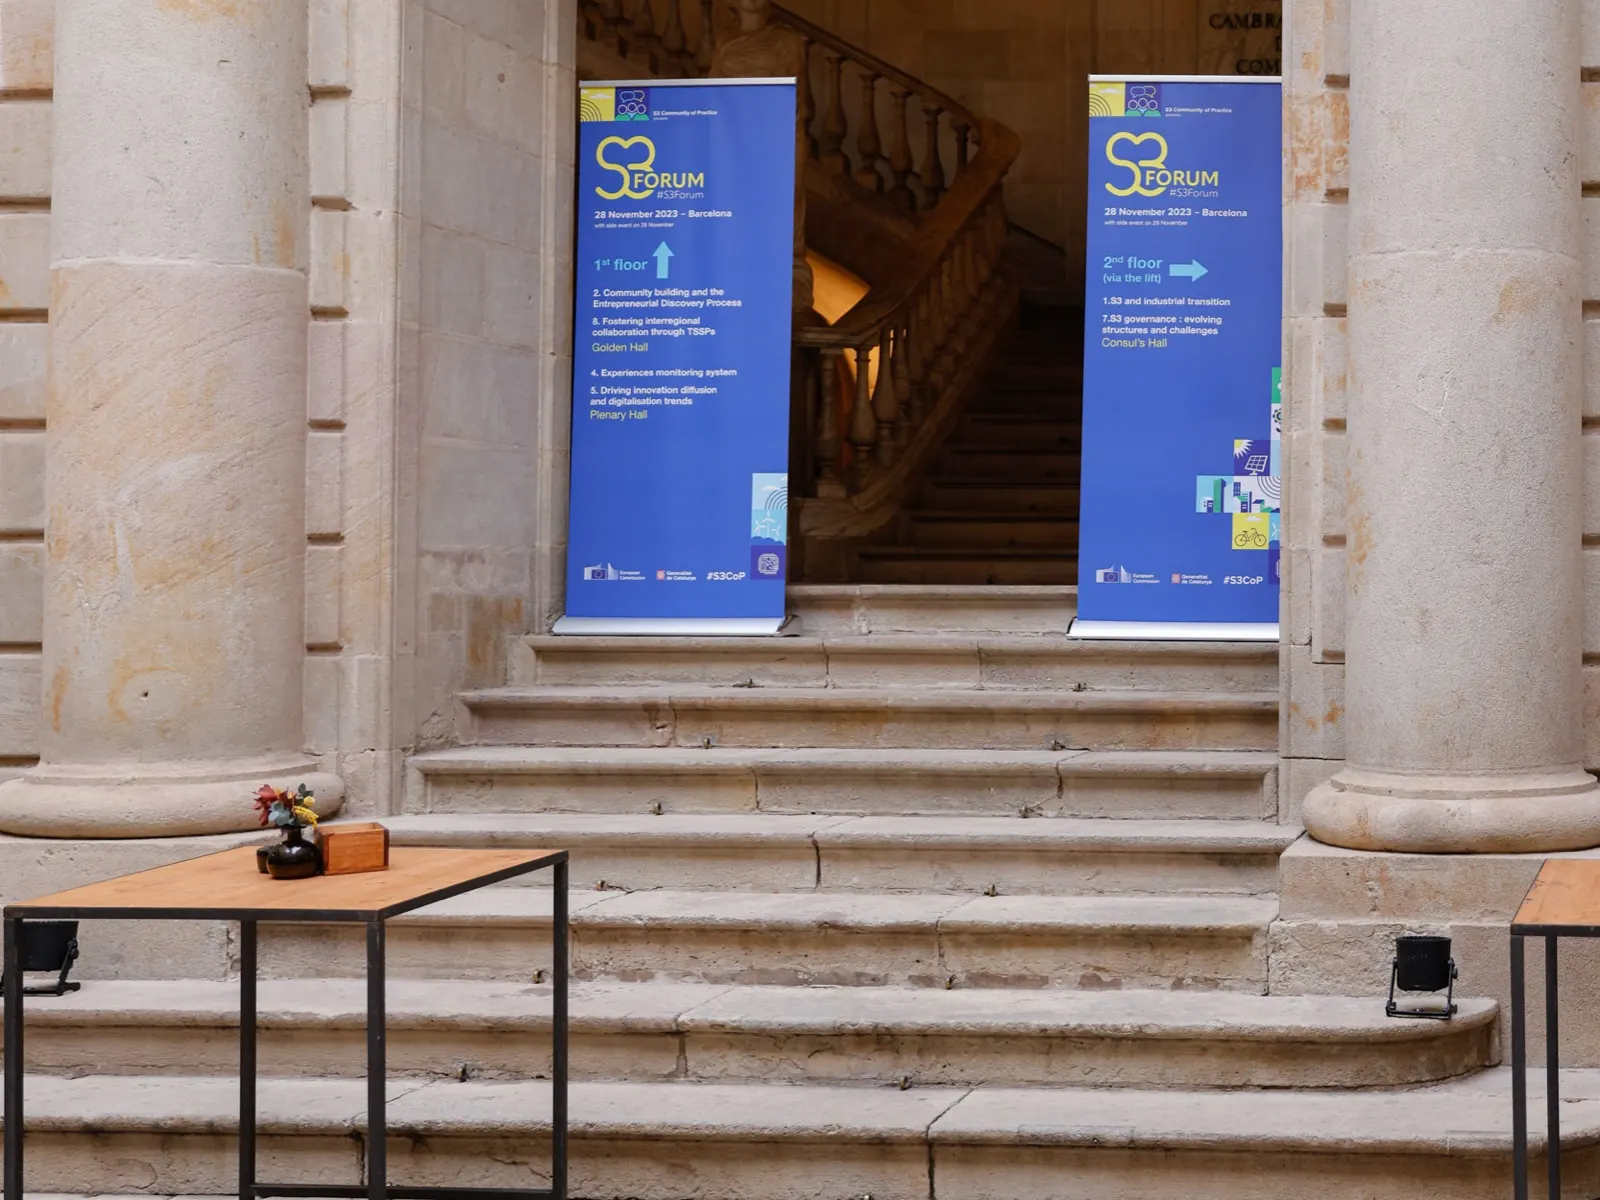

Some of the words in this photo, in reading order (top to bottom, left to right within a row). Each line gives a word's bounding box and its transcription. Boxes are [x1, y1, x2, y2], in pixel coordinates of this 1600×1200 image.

[1236, 59, 1281, 74] COM
[633, 172, 704, 189] FORUM
[1145, 170, 1219, 187] FORUM
[656, 190, 704, 200] #S3Forum
[1169, 188, 1218, 198] #S3Forum
[594, 210, 606, 219] 28
[608, 210, 653, 219] November
[655, 210, 678, 218] 2023
[688, 209, 732, 218] Barcelona
[1104, 207, 1117, 216] 28
[1118, 207, 1166, 216] November
[1167, 208, 1192, 216] 2023
[1202, 208, 1248, 217] Barcelona
[594, 258, 611, 271] 1st
[614, 257, 648, 271] floor
[1103, 256, 1124, 269] 2nd
[1127, 256, 1163, 269] floor
[1103, 274, 1123, 284] (via
[1125, 274, 1142, 283] the
[1144, 273, 1161, 284] lift)
[593, 289, 601, 297] 2.
[603, 289, 652, 298] Community
[654, 288, 690, 297] building
[692, 288, 708, 296] and
[710, 288, 724, 296] the
[593, 299, 659, 309] Entrepreneurial
[661, 299, 704, 308] Discovery
[706, 299, 742, 307] Process
[1103, 297, 1122, 305] 1.S3
[1124, 297, 1141, 305] and
[1143, 297, 1185, 305] industrial
[1187, 298, 1231, 306] transition
[592, 317, 600, 325] 8.
[602, 317, 643, 326] Fostering
[645, 317, 700, 327] interregional
[1102, 315, 1122, 323] 7.S3
[1124, 315, 1177, 325] governance
[1184, 315, 1222, 325] evolving
[592, 328, 649, 336] collaboration
[651, 328, 685, 337] through
[687, 327, 716, 336] TSSPs
[1102, 326, 1148, 334] structures
[1150, 326, 1167, 334] and
[1169, 326, 1218, 336] challenges
[591, 343, 627, 352] Golden
[629, 343, 649, 352] Hall
[1148, 338, 1167, 348] Hall
[591, 369, 599, 377] 4.
[601, 369, 654, 378] Experiences
[655, 368, 704, 378] monitoring
[705, 368, 737, 378] system
[590, 387, 598, 395] 5.
[600, 386, 632, 396] Driving
[633, 386, 678, 395] innovation
[680, 386, 717, 394] diffusion
[590, 398, 607, 406] and
[608, 397, 662, 406] digitalisation
[664, 397, 693, 405] trends
[590, 410, 626, 421] Plenary
[629, 410, 648, 419] Hall
[706, 572, 746, 580] #S3CoP
[1223, 575, 1263, 585] #S3CoP
